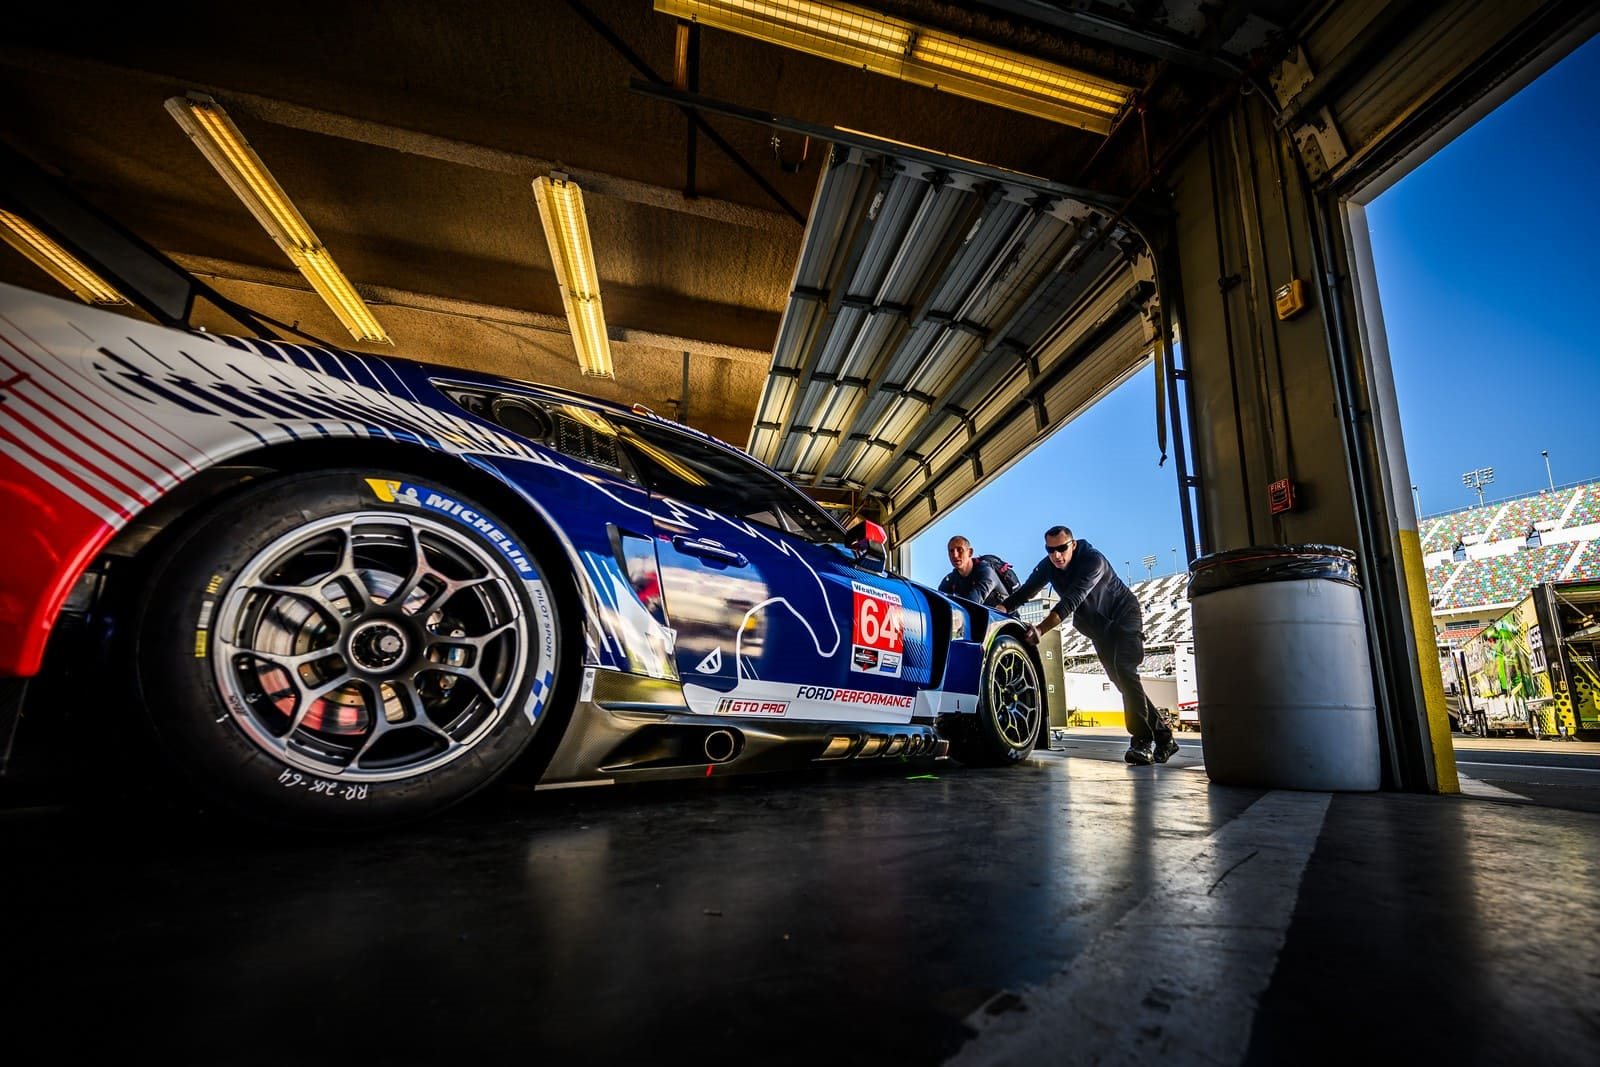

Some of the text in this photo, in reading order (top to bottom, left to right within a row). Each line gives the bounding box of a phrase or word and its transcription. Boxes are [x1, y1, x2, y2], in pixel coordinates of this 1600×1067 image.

[1270, 480, 1286, 492] FIRE
[425, 493, 533, 572] MICHELIN
[853, 583, 900, 603] WeatherTech
[534, 589, 553, 660] PILOT SPORT
[860, 598, 899, 649] 64
[731, 701, 787, 714] GTD PRO
